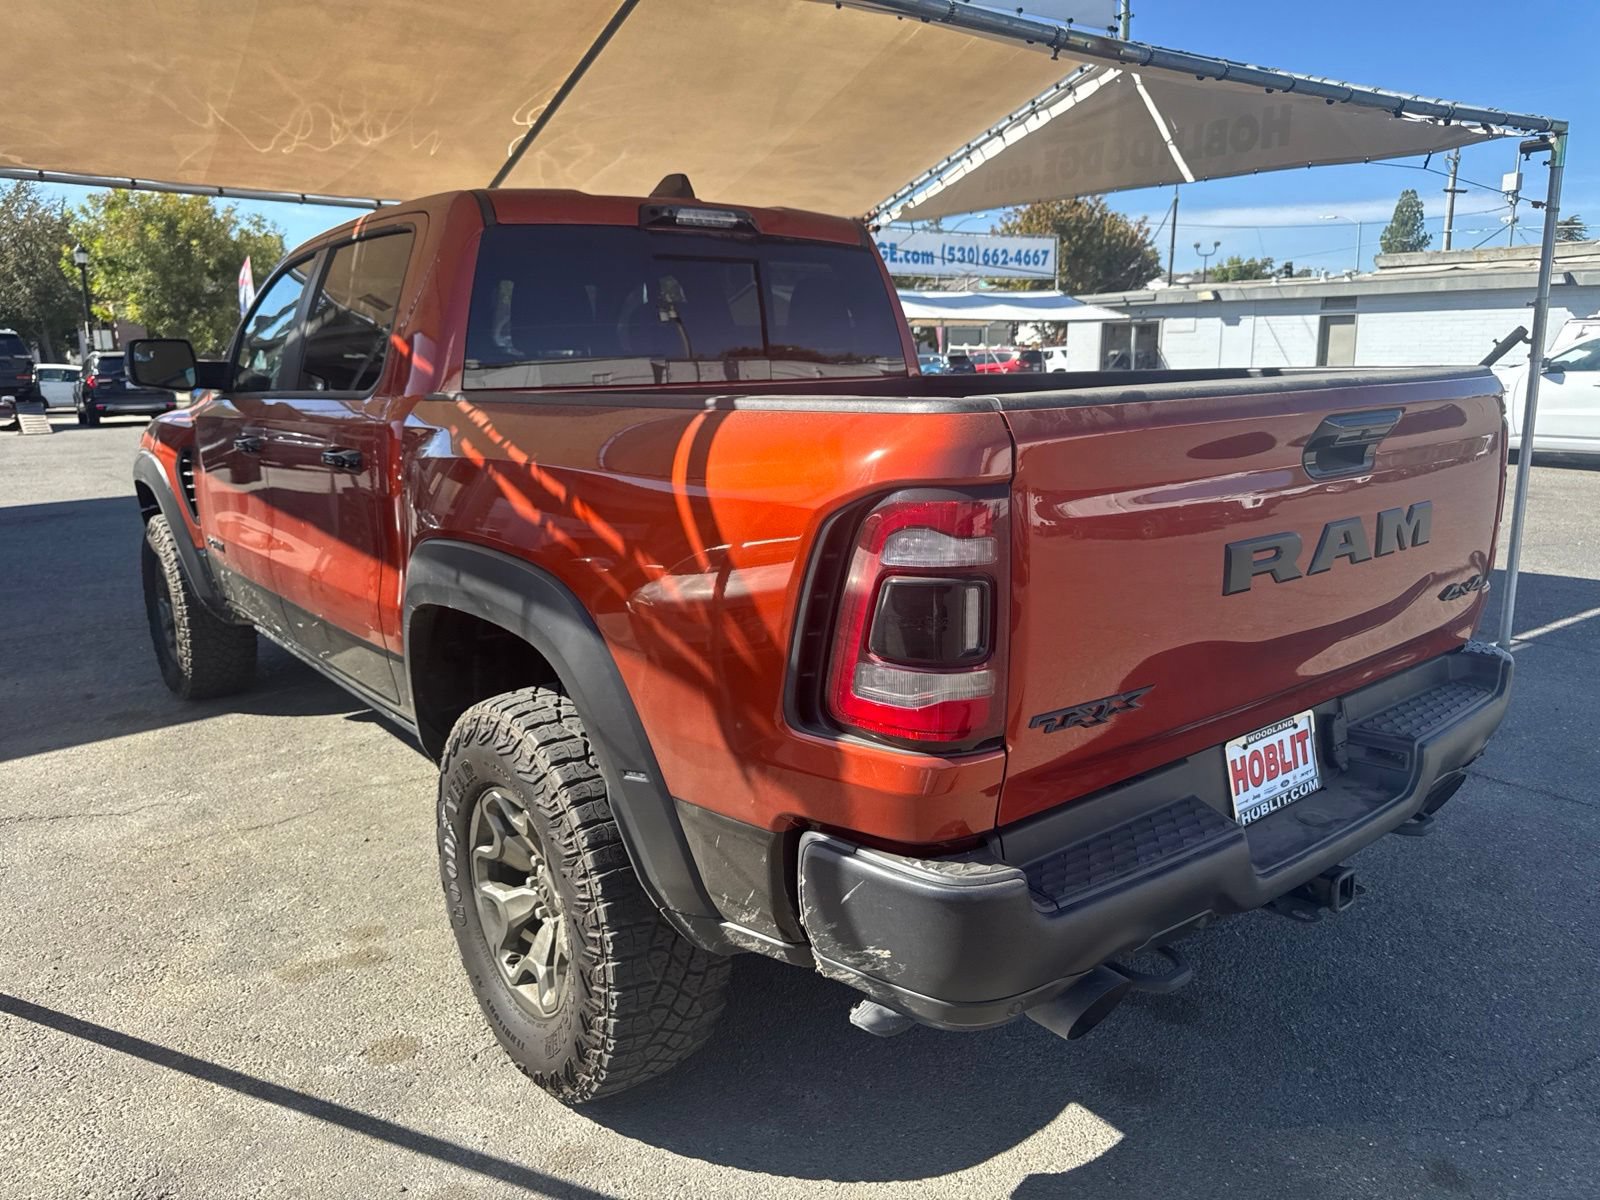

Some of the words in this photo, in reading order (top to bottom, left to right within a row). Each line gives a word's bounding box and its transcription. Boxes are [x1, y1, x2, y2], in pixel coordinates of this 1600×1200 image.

[1222, 500, 1432, 596] RAM
[1029, 683, 1156, 734] TRX
[1248, 720, 1294, 743] WOODLAND
[1230, 728, 1310, 796] HOBLIT
[1241, 779, 1319, 825] HOBLIT.COM
